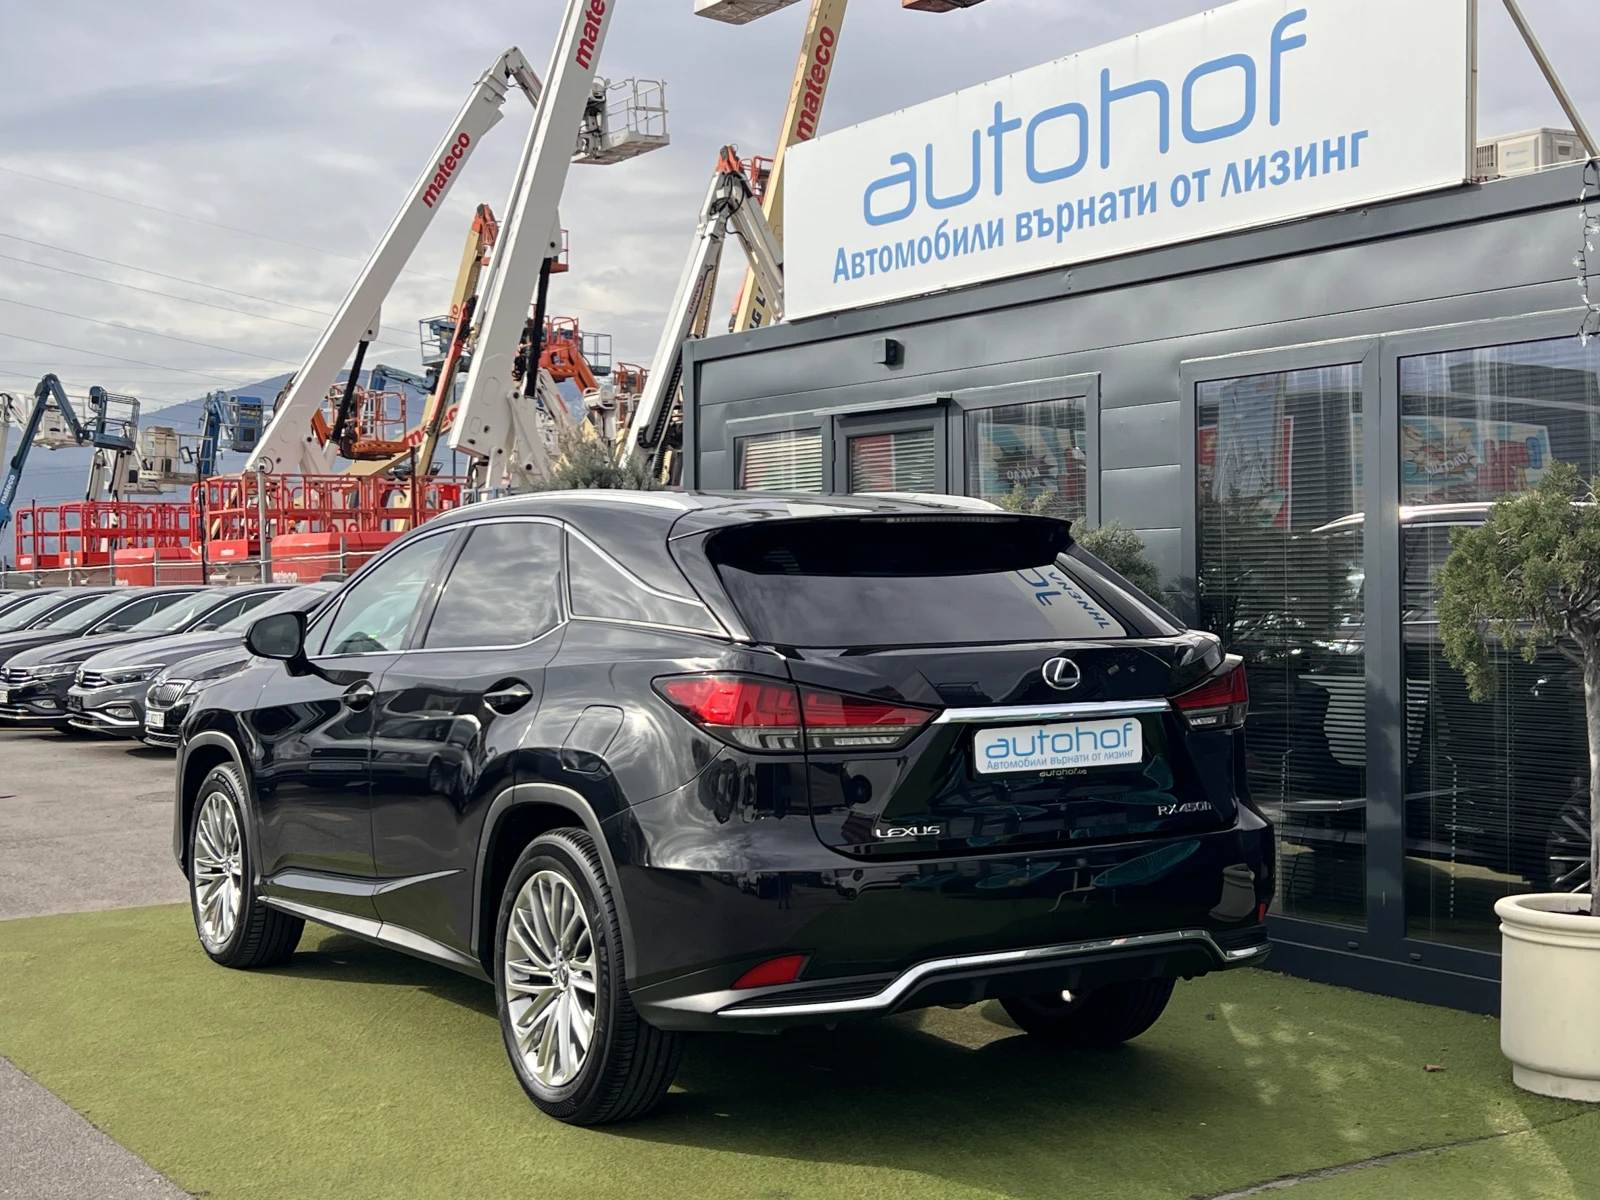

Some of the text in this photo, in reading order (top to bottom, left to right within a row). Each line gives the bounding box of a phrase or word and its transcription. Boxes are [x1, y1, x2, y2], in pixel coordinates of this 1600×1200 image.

[796, 25, 835, 141] mateco
[864, 10, 1306, 225] autohof
[422, 132, 470, 208] mateco
[834, 130, 1368, 282] Автомобили върнати от лизинг
[985, 722, 1133, 760] autohof
[986, 749, 1135, 771] Автомобили върнати от лизинг
[875, 825, 941, 838] LEXUS
